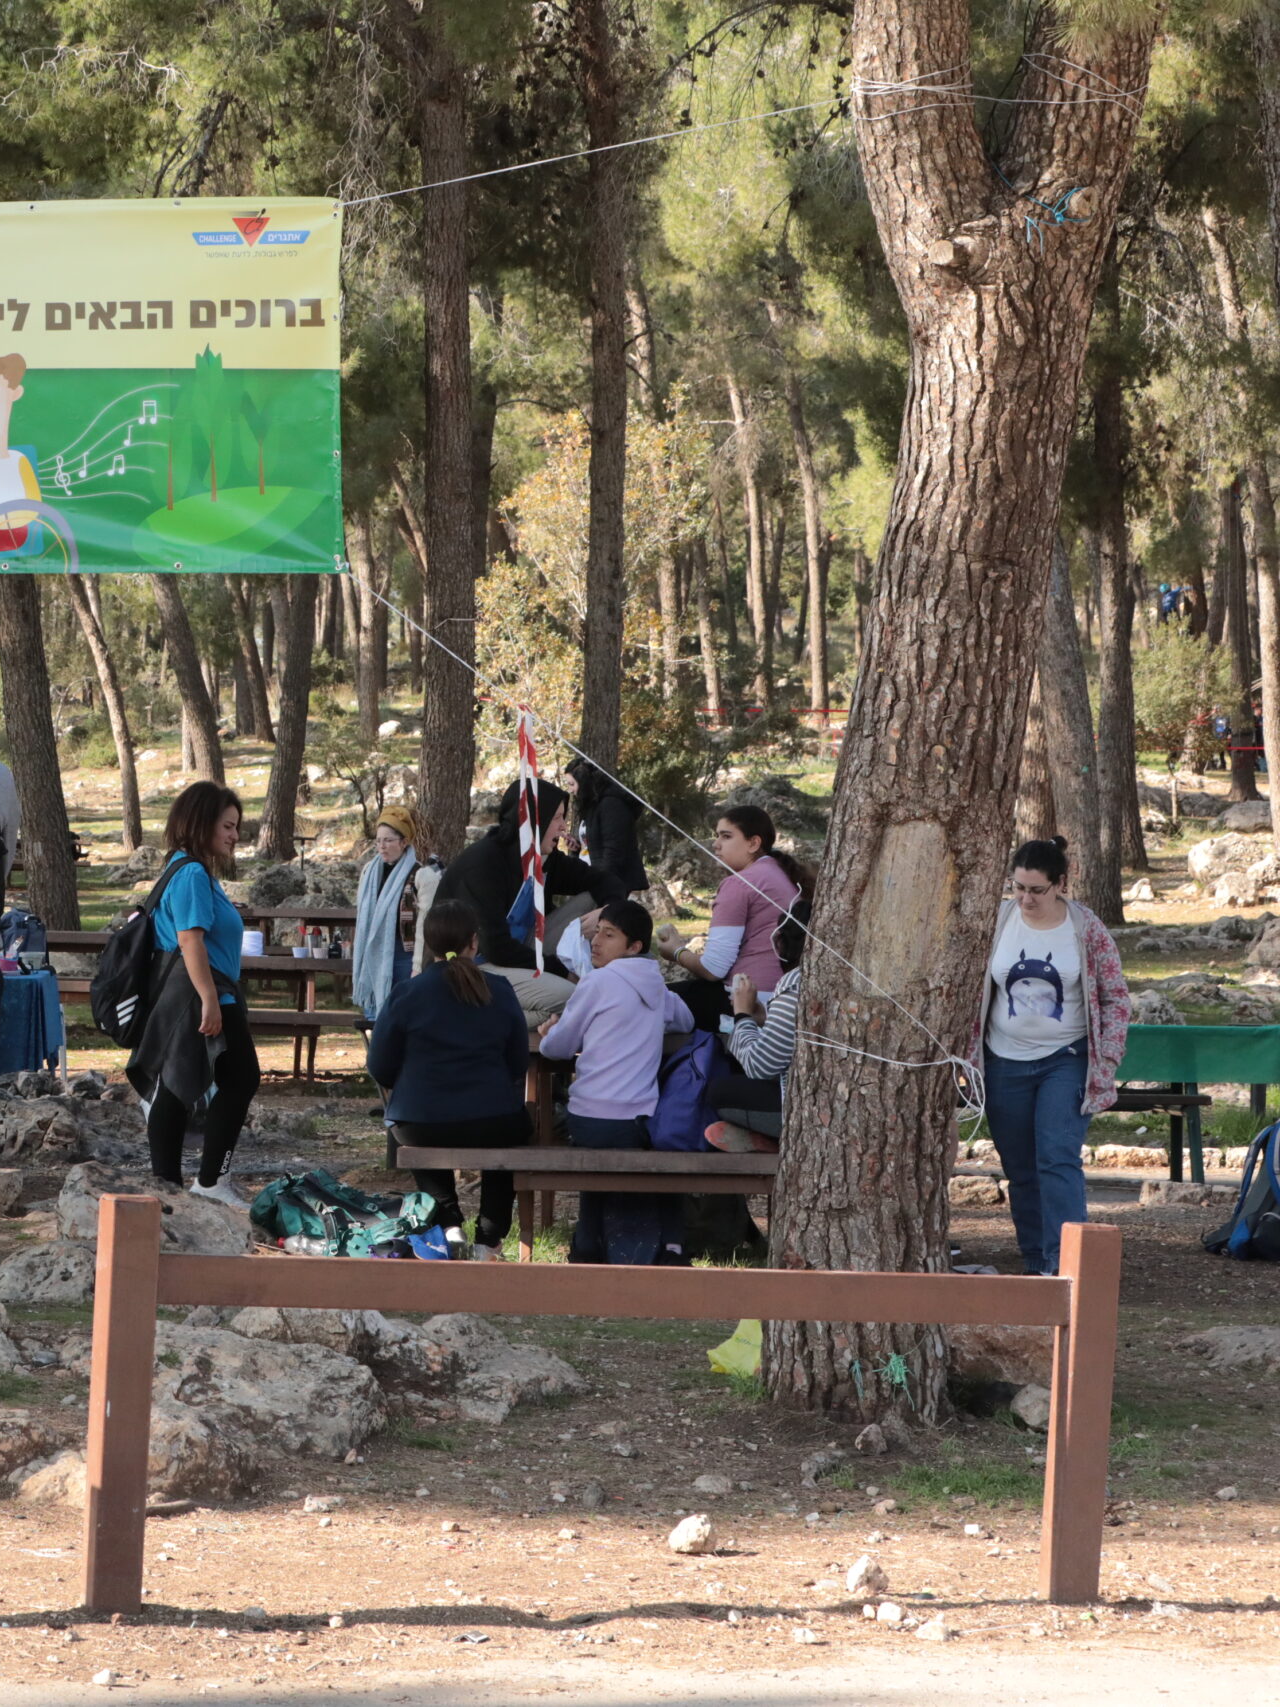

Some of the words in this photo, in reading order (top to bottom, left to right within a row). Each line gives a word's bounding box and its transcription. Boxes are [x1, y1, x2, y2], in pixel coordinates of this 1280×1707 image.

[198, 233, 238, 243] CHALLENGE
[267, 233, 301, 242] אתגרים
[45, 300, 173, 331] הבאים
[190, 298, 325, 329] ברוכים
